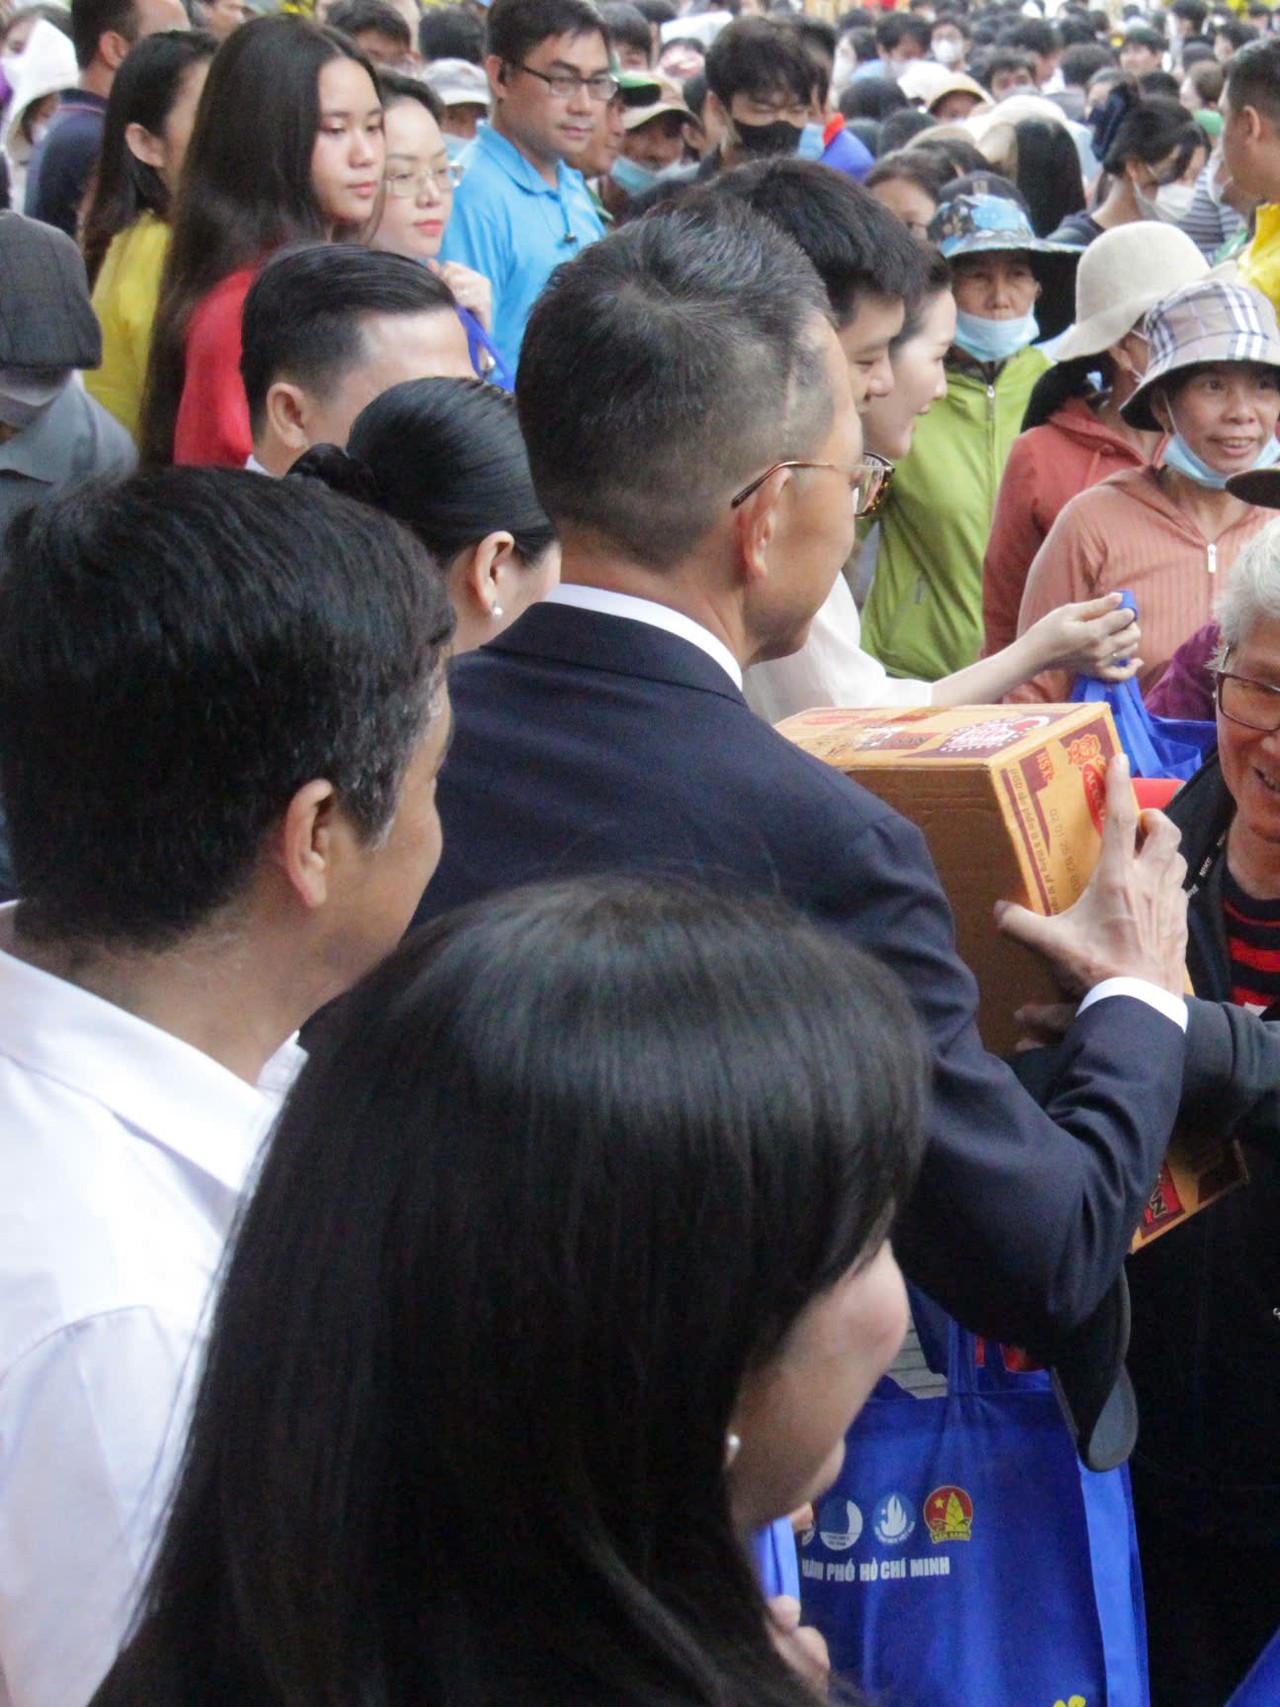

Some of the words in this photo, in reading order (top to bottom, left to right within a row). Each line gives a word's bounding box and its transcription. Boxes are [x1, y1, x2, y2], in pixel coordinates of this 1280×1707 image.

[826, 1558, 855, 1582] PHỐ
[880, 1557, 906, 1580] CHÍ
[910, 1556, 950, 1578] MINH
